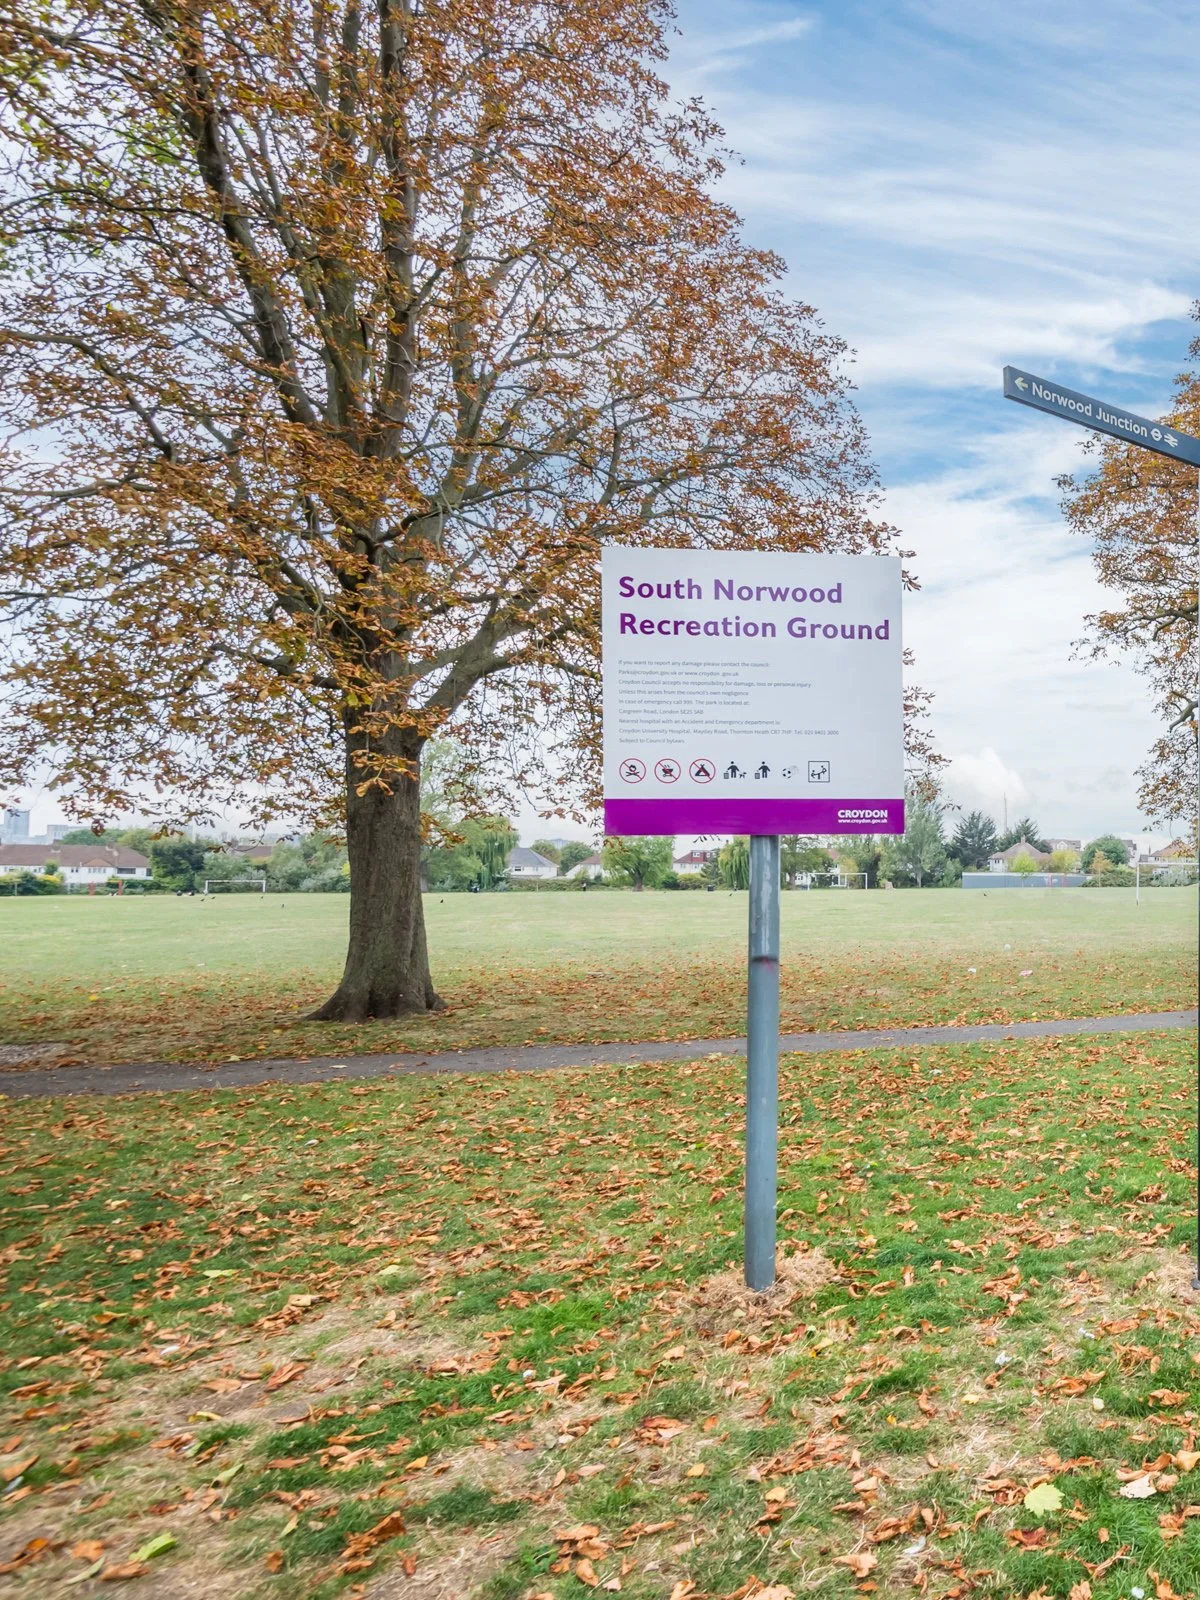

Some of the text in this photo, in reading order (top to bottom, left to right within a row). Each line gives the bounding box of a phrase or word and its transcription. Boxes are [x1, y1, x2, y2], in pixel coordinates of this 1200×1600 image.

[1032, 382, 1148, 437] Norwood Junction
[619, 576, 842, 603] South Norwood
[620, 613, 889, 640] Recreation Ground
[838, 810, 888, 818] CROYDON
